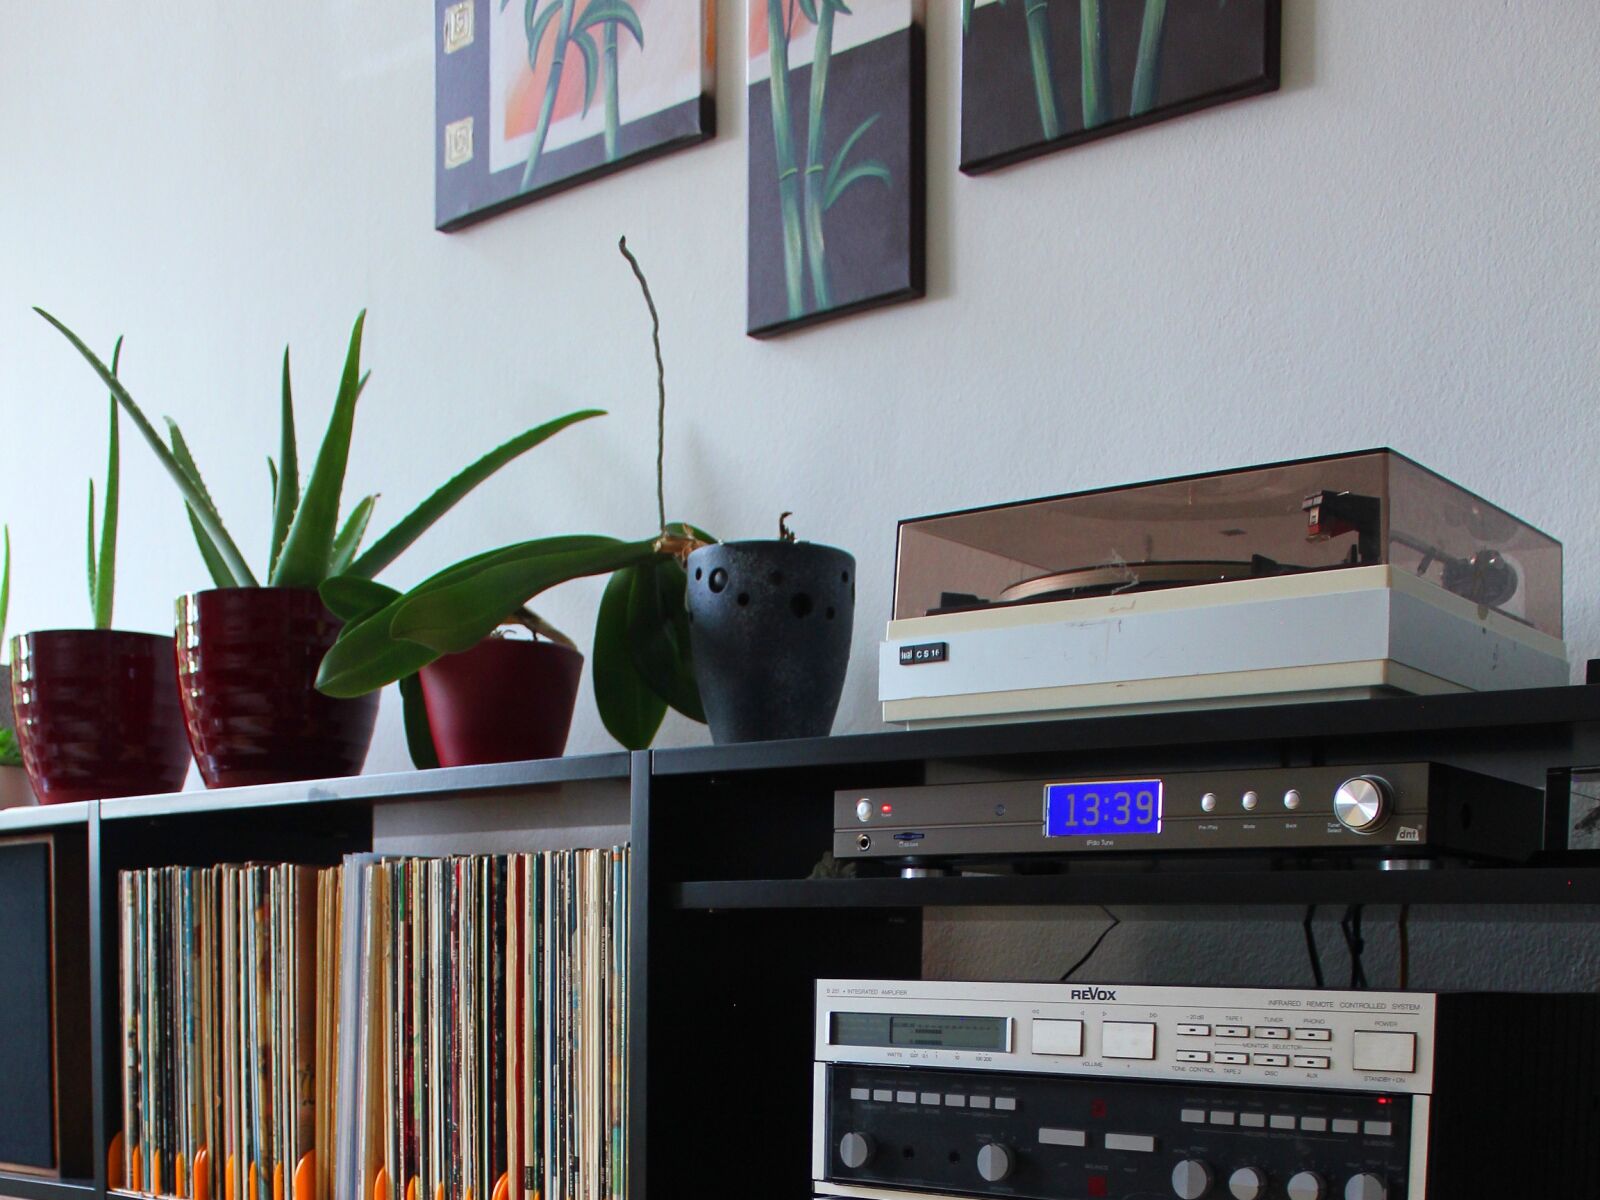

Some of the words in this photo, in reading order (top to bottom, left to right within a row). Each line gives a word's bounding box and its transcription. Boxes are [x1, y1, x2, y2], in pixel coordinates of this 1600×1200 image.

[1065, 790, 1154, 828] 13:39
[1399, 829, 1417, 839] dnt
[1339, 1002, 1387, 1010] CONTROLLED
[1392, 1003, 1421, 1011] SYSTEM
[1189, 1066, 1215, 1074] CONTROL
